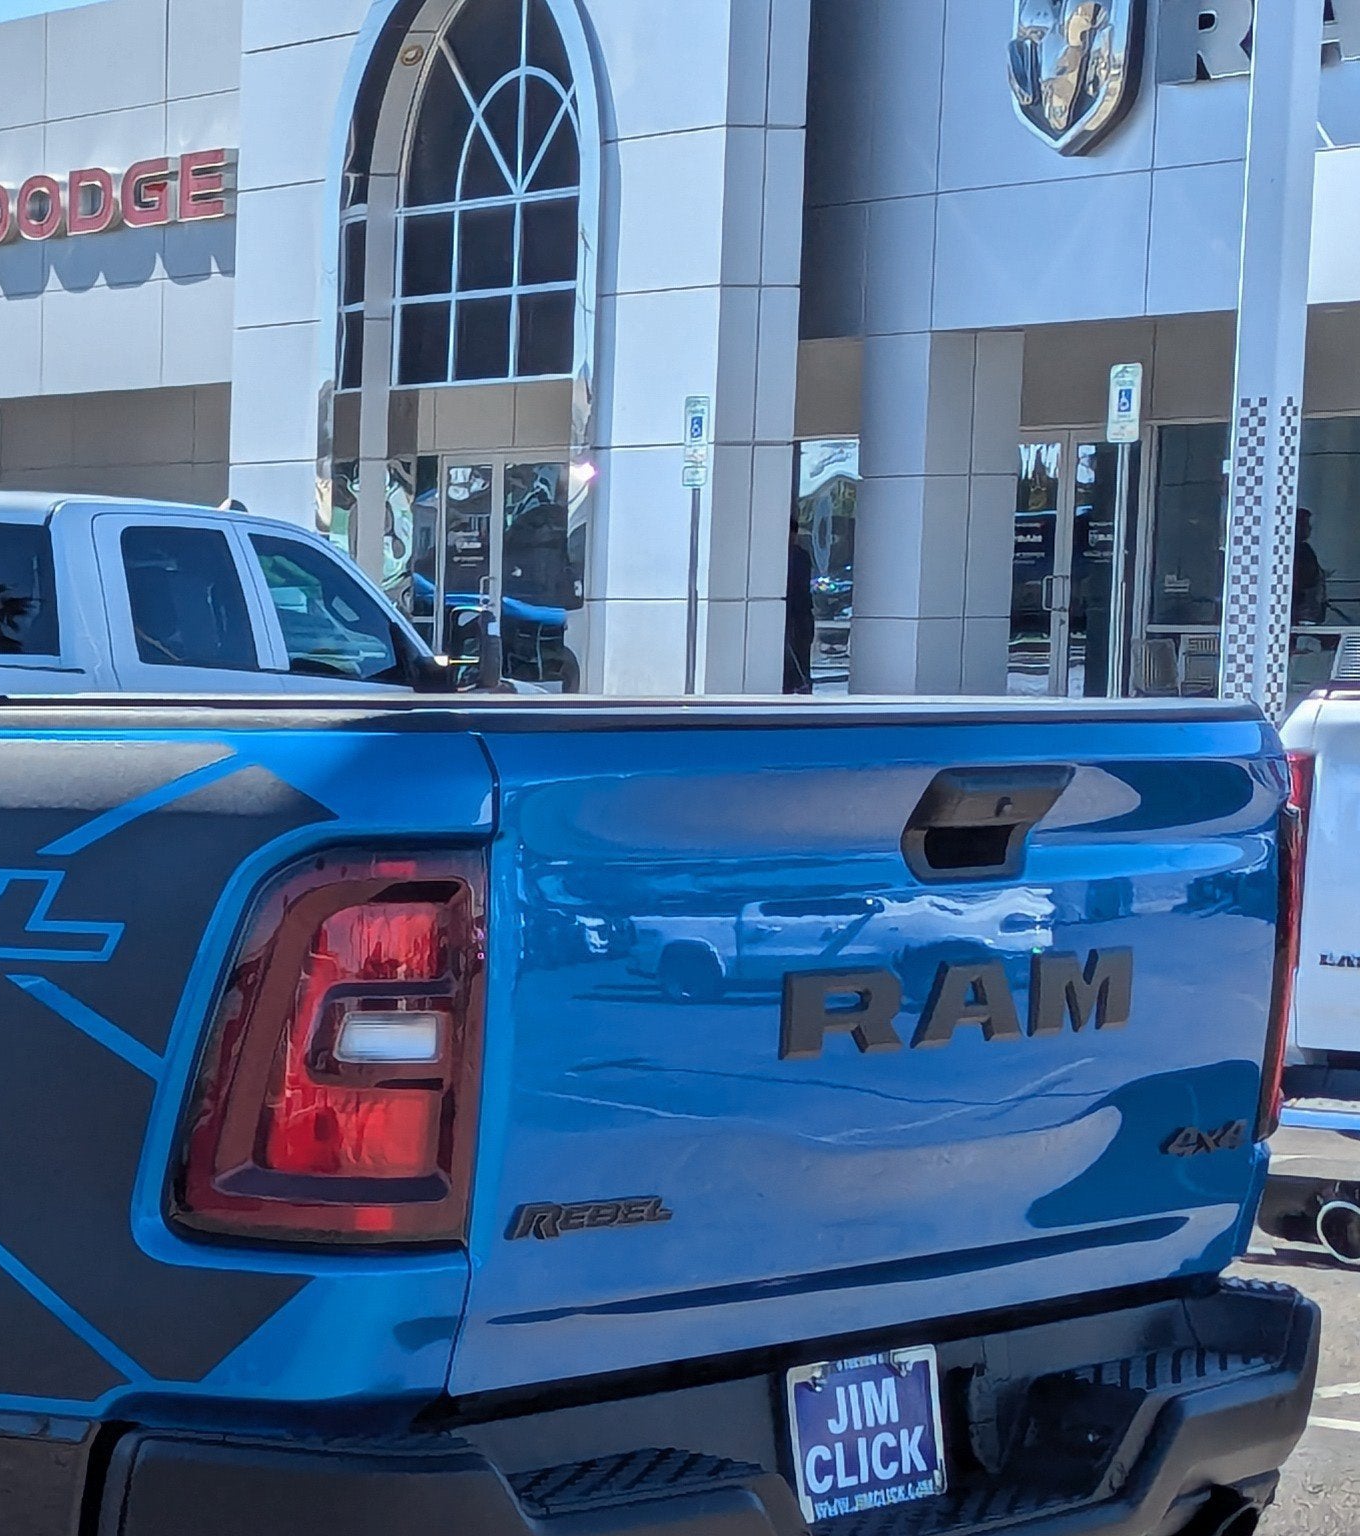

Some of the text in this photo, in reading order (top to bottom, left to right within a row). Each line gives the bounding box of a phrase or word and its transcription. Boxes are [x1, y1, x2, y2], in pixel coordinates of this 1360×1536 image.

[778, 946, 1133, 1061] RAM
[503, 1195, 673, 1240] REBEL
[827, 1377, 899, 1434] JIM
[805, 1425, 927, 1494] CLICK
